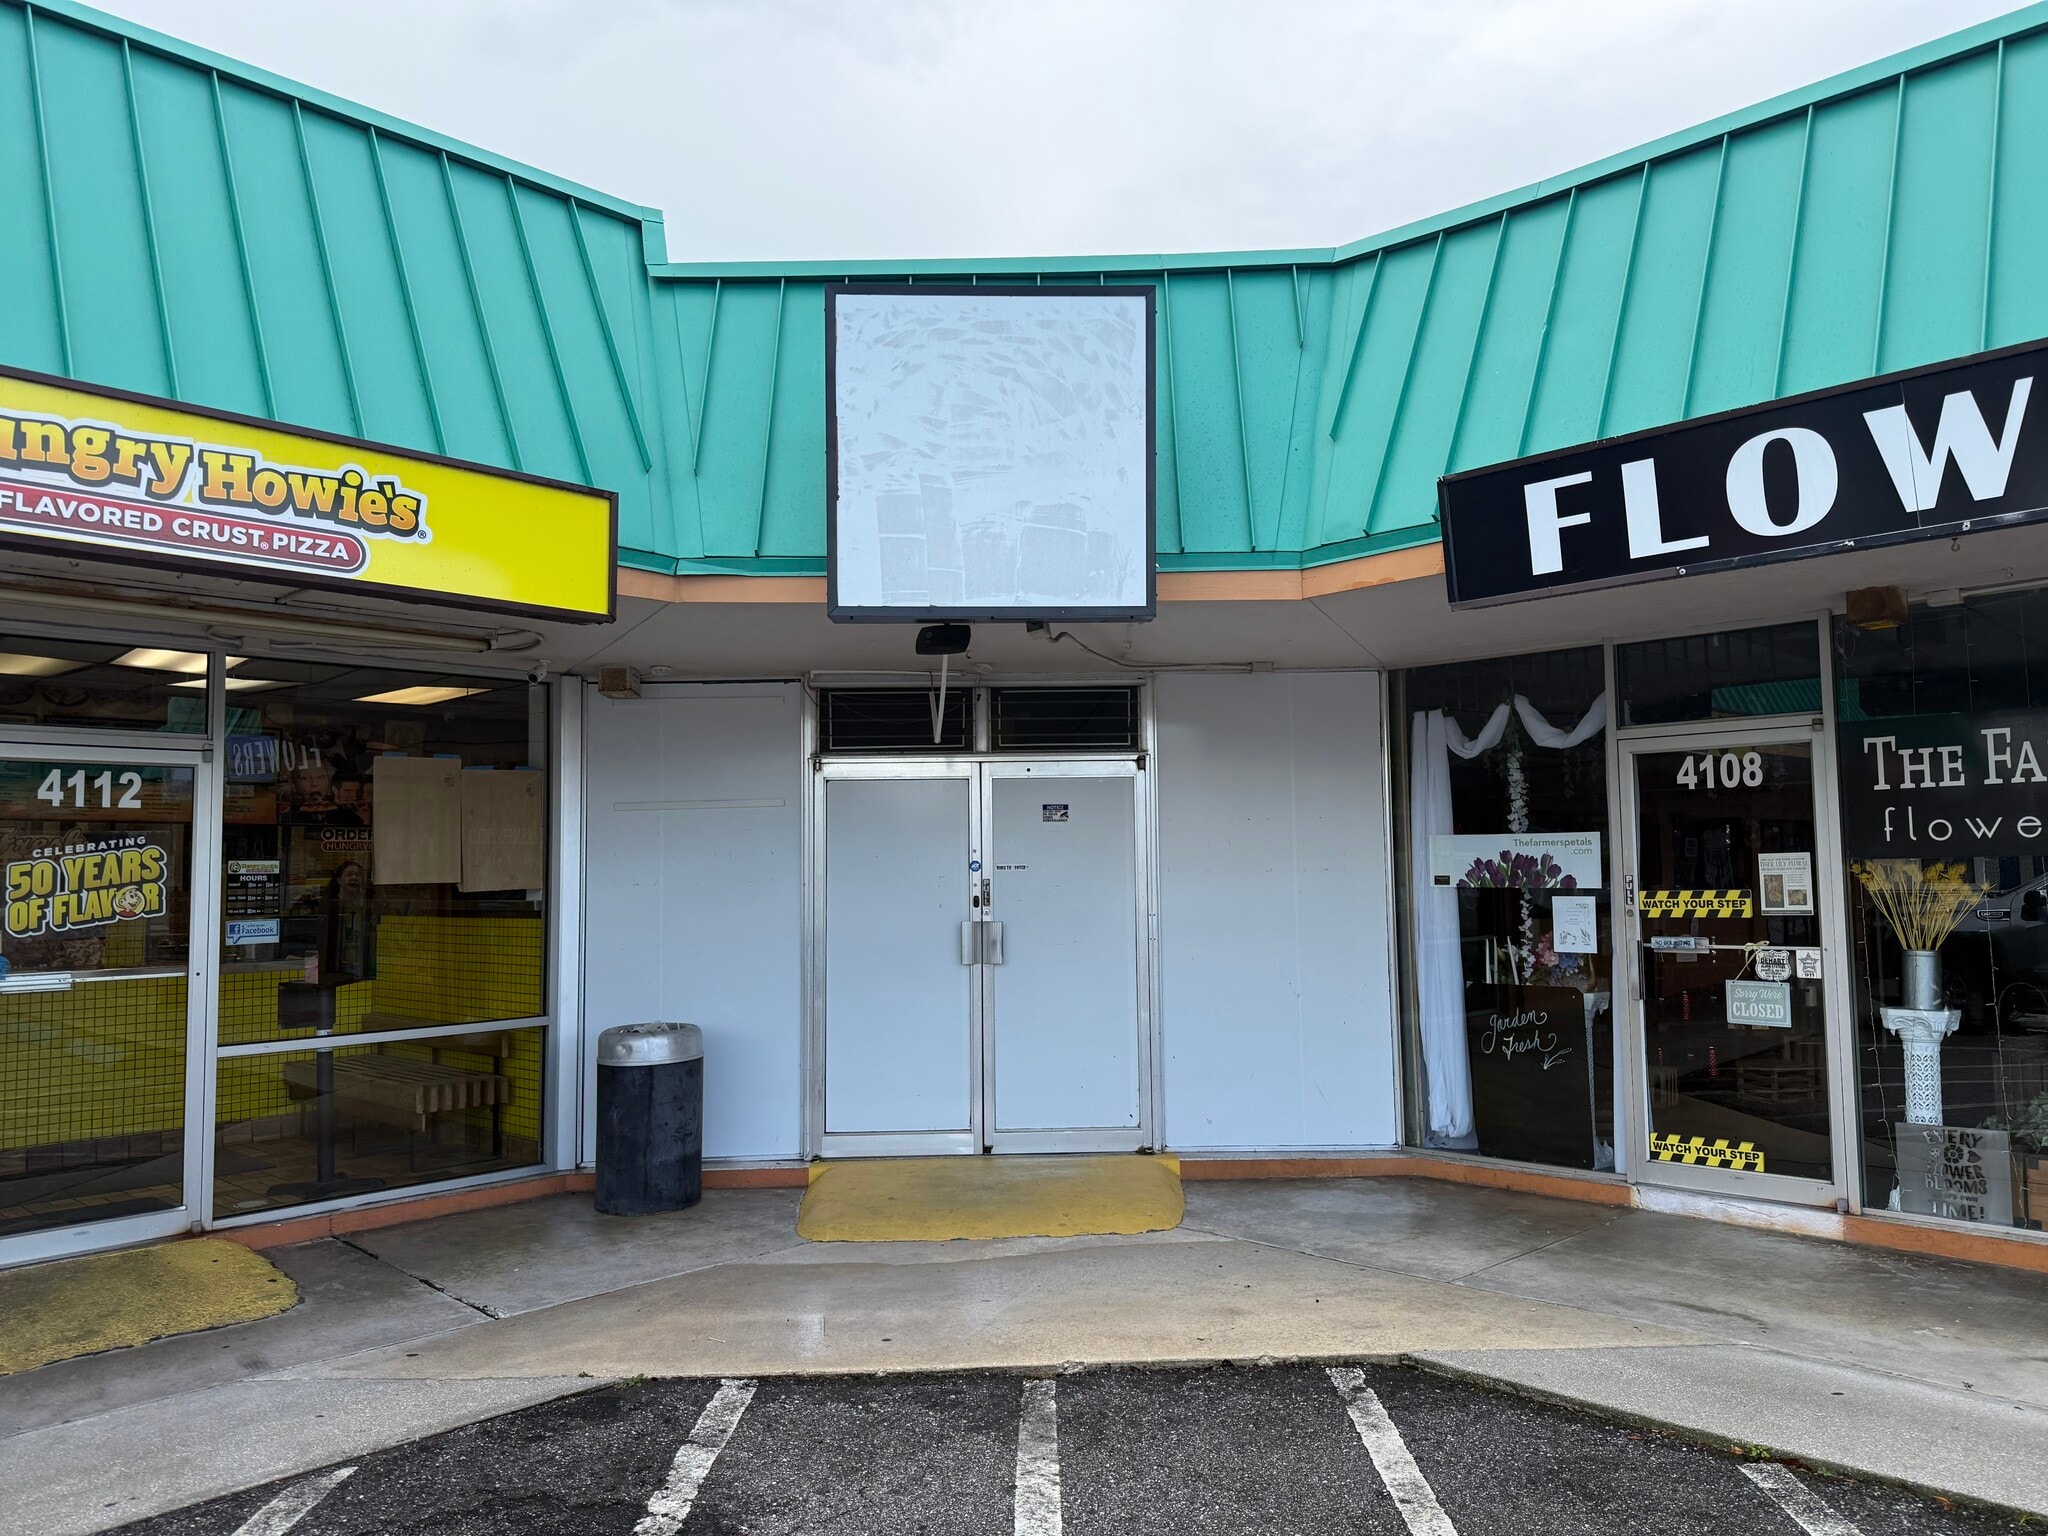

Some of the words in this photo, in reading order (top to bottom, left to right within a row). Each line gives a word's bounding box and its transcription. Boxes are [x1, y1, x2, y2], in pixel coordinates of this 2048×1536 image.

[1523, 376, 2034, 576] FLOW
[202, 452, 417, 530] Howie's
[0, 490, 163, 532] FLAVORED
[172, 517, 264, 547] CRUST
[273, 532, 349, 561] PIZZA
[1676, 752, 1763, 790] 4108
[37, 769, 142, 809] 4112
[1884, 805, 2043, 842] flowe
[33, 836, 146, 858] CELEBRATING
[1513, 837, 1593, 848] Thefarmerspetals
[9, 860, 54, 900] 50
[63, 848, 161, 890] YEARS
[1625, 875, 1634, 905] PULL
[8, 898, 45, 932] OF
[1642, 900, 1680, 909] WATCH
[1683, 900, 1715, 909] YOUR
[1717, 899, 1747, 909] STEP
[241, 926, 274, 934] Facebook
[1734, 988, 1758, 1002] Sorry
[1732, 1002, 1784, 1019] CLOSED
[1652, 1141, 1691, 1154] WATCH
[1695, 1146, 1727, 1158] YOUR
[1730, 1150, 1760, 1161] STEP
[1923, 1129, 1983, 1149] EVERY
[1928, 1199, 1985, 1220] TIME!
